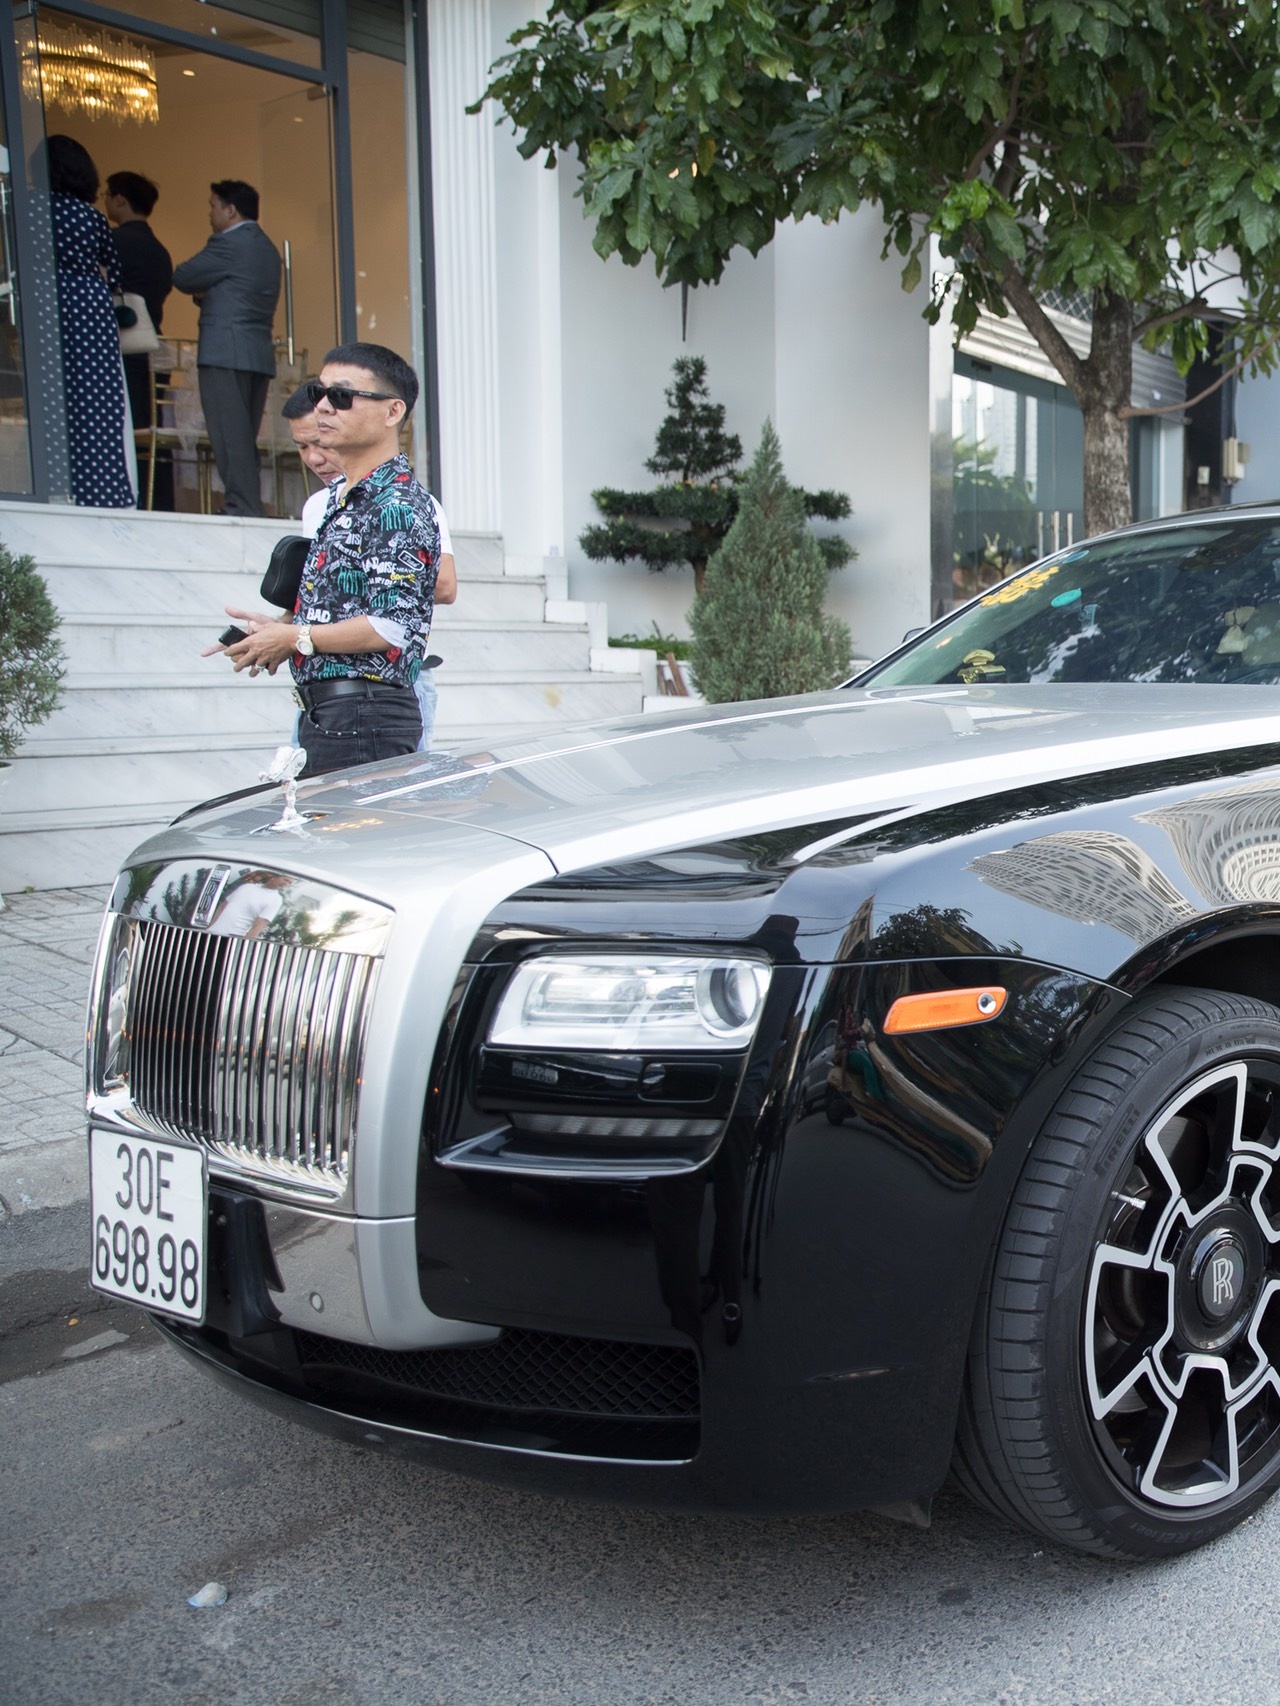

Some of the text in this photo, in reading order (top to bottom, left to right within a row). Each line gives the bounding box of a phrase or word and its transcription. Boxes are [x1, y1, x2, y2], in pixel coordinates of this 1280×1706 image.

[307, 608, 331, 623] BAD
[1092, 1102, 1141, 1177] PIRELLI
[116, 1143, 174, 1222] 30E
[96, 1214, 199, 1308] 698.98
